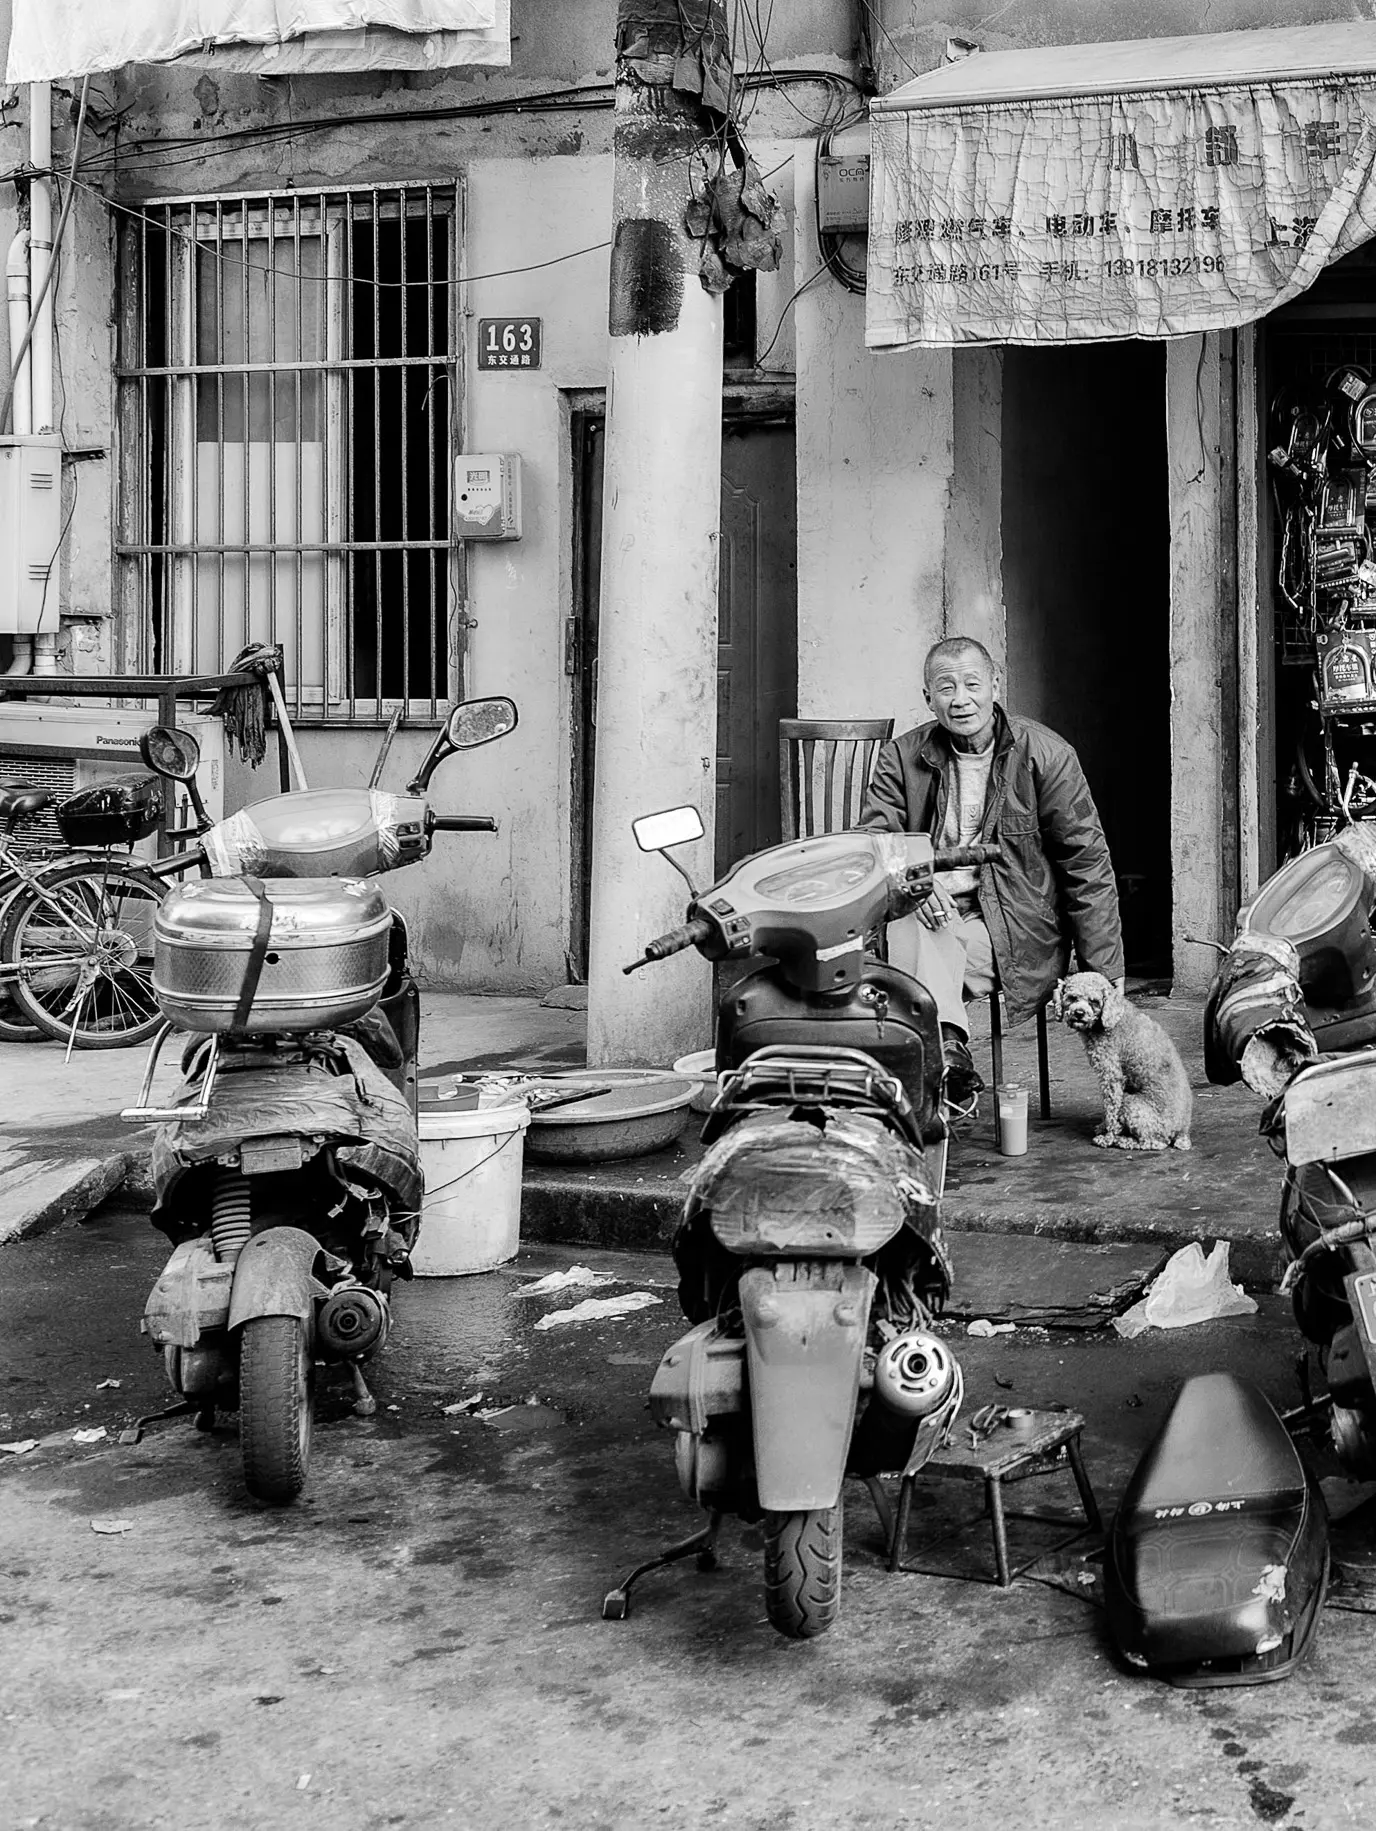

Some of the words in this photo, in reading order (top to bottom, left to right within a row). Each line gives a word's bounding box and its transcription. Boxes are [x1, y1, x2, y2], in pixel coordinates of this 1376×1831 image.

[486, 324, 533, 352] 163
[487, 354, 532, 366] 东交通路
